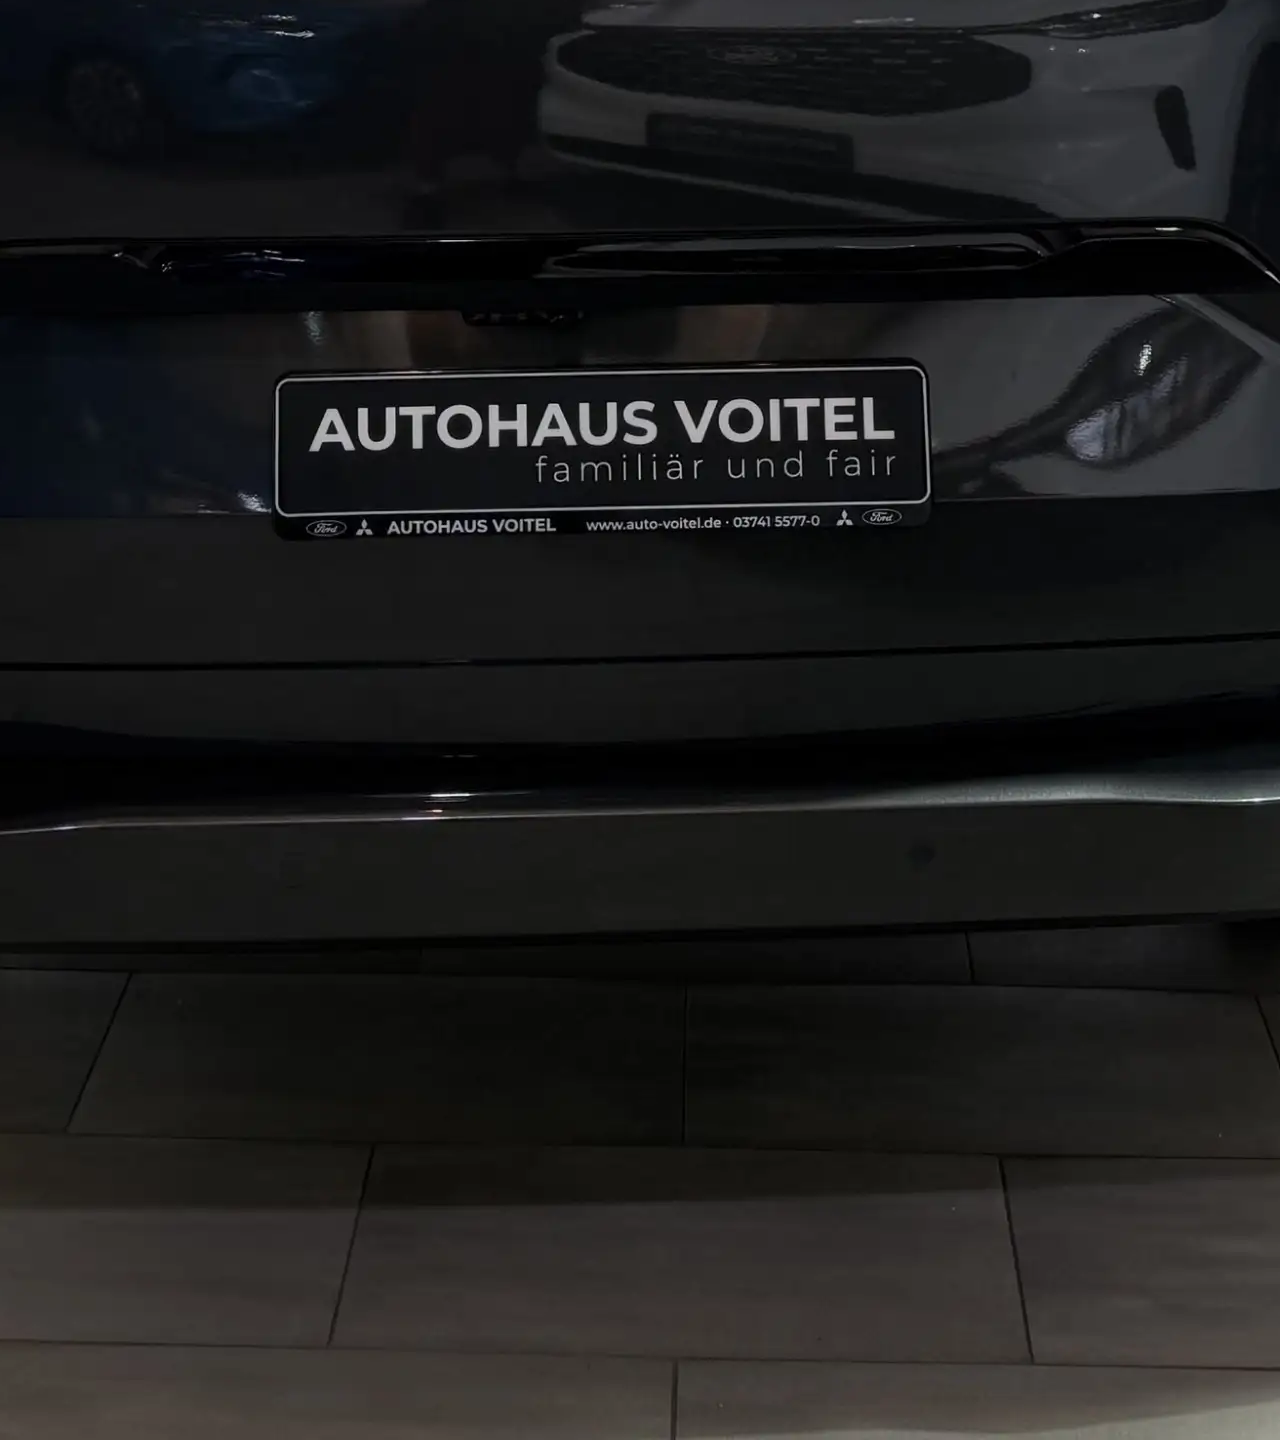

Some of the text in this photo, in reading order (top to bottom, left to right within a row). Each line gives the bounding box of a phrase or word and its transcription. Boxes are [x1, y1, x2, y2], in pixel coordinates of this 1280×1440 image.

[309, 396, 895, 452] AUTOHAUS VOITEL
[535, 449, 897, 483] familiär und fair
[310, 510, 897, 535] Ford AUTOHAUS VOITEL www.auto-voitel.de 03741 5577-0 Ford
